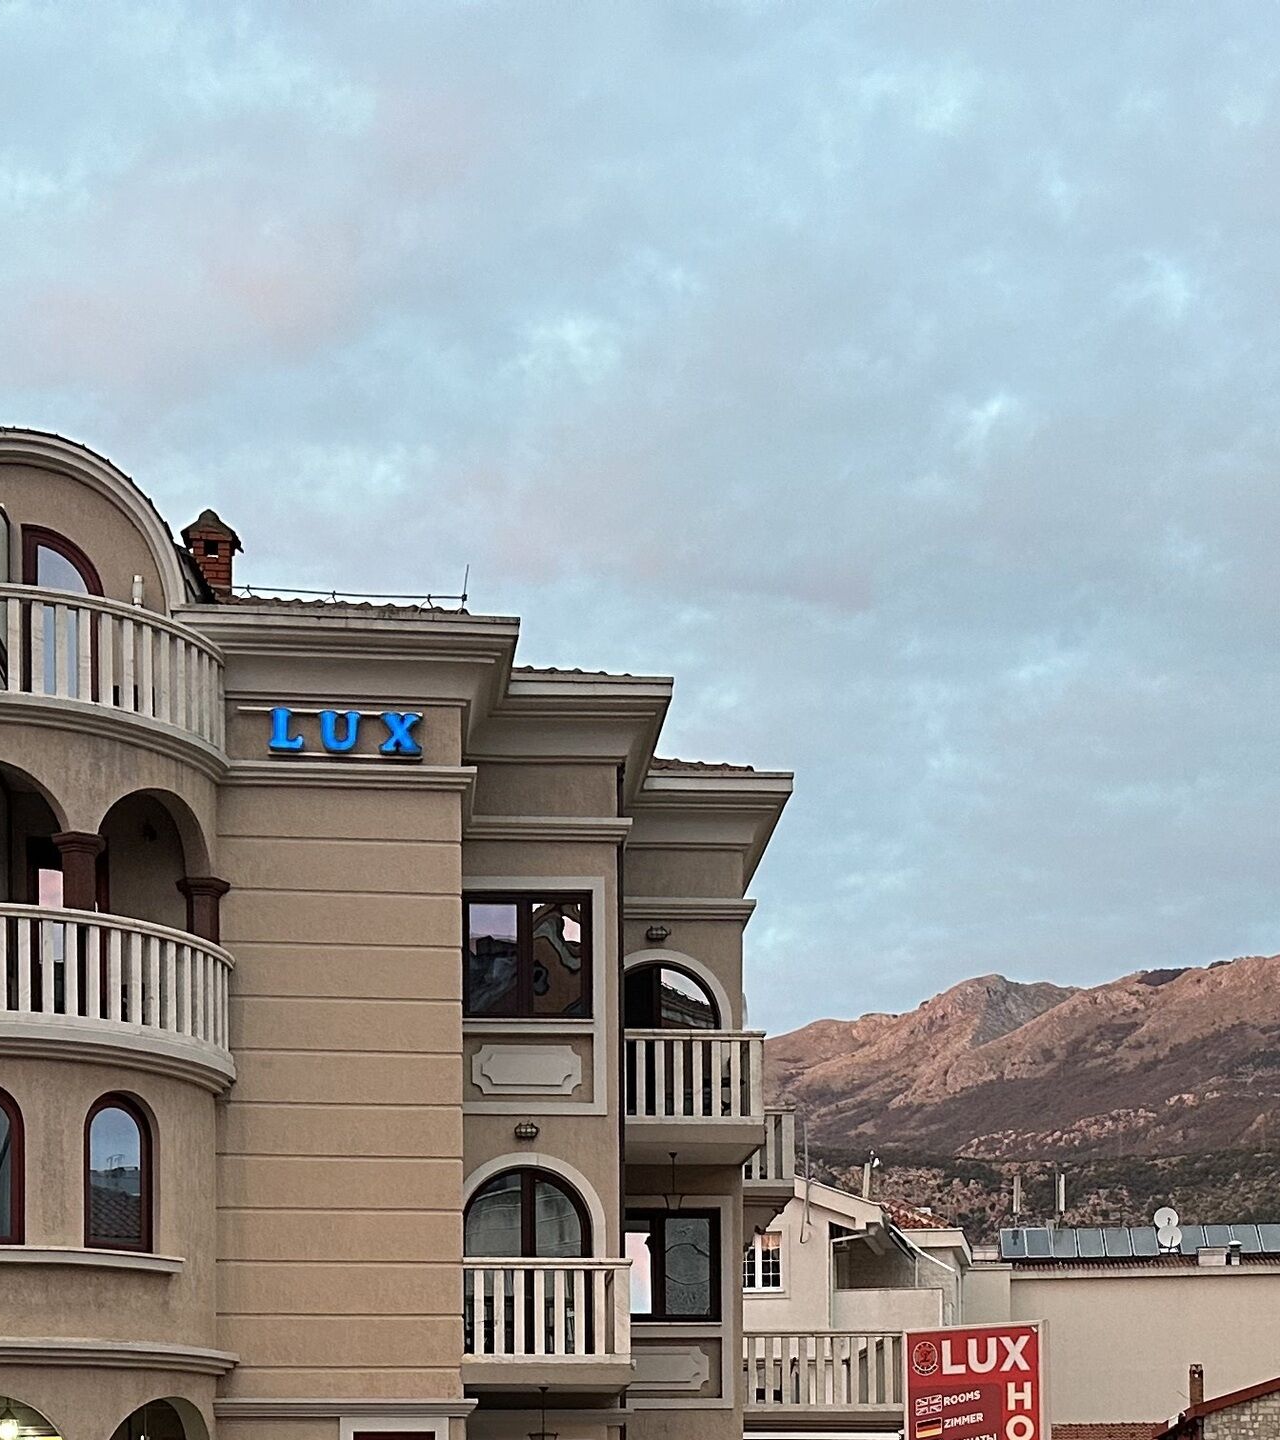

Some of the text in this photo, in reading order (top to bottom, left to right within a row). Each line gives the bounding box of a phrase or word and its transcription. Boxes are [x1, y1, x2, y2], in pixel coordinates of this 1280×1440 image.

[269, 707, 422, 755] LUX
[941, 1335, 1031, 1375] LUX
[943, 1390, 981, 1406] ROOMS
[943, 1412, 984, 1429] ZIMMER
